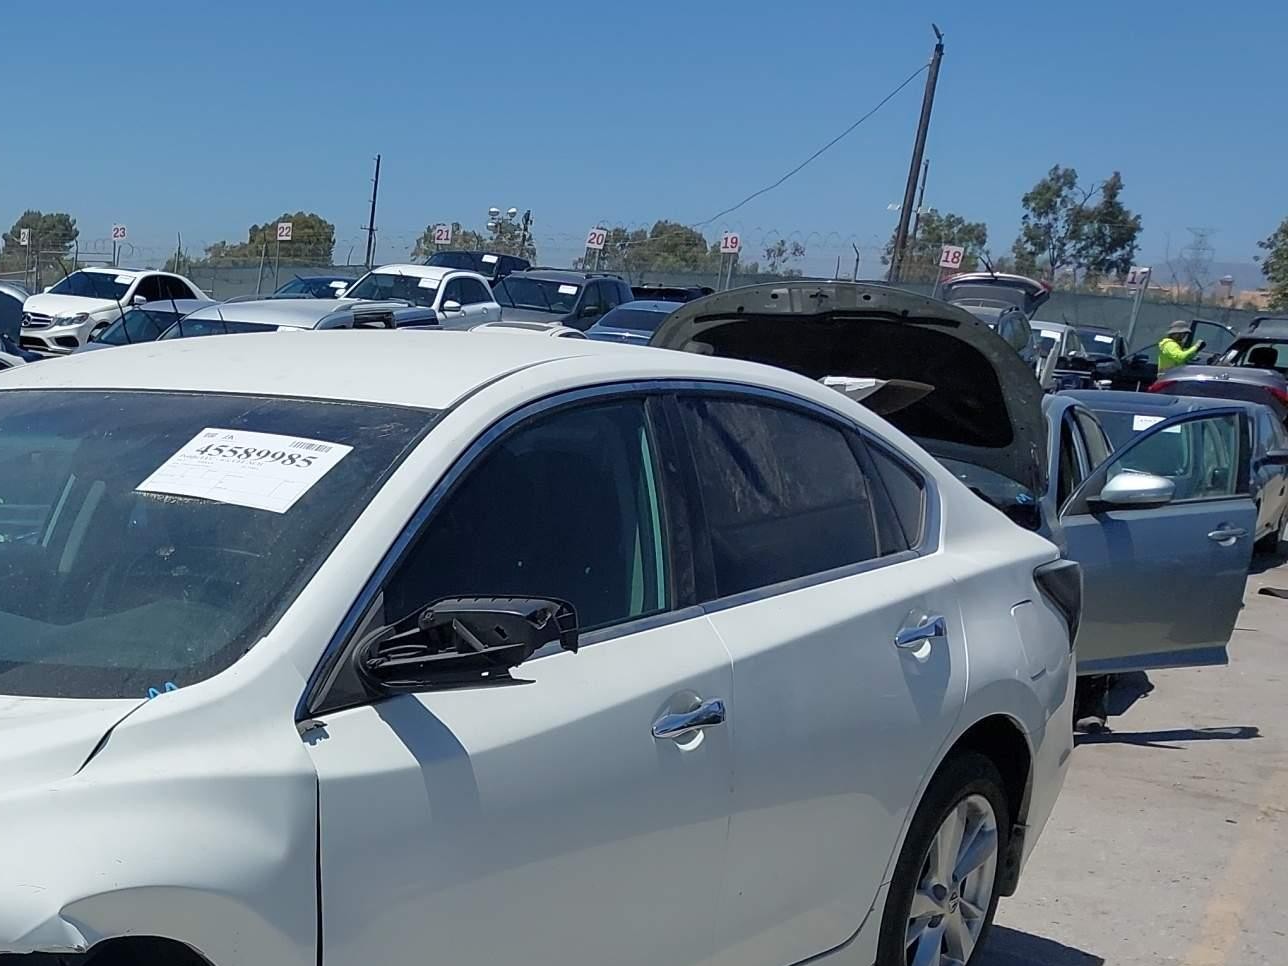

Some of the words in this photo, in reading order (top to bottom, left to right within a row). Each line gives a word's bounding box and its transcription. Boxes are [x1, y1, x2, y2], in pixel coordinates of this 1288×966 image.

[113, 227, 126, 238] 23
[278, 226, 291, 237] 22
[436, 229, 450, 240] 21
[587, 232, 605, 245] 20
[721, 236, 738, 248] 19
[942, 250, 961, 264] 18
[196, 443, 319, 468] 45589985
